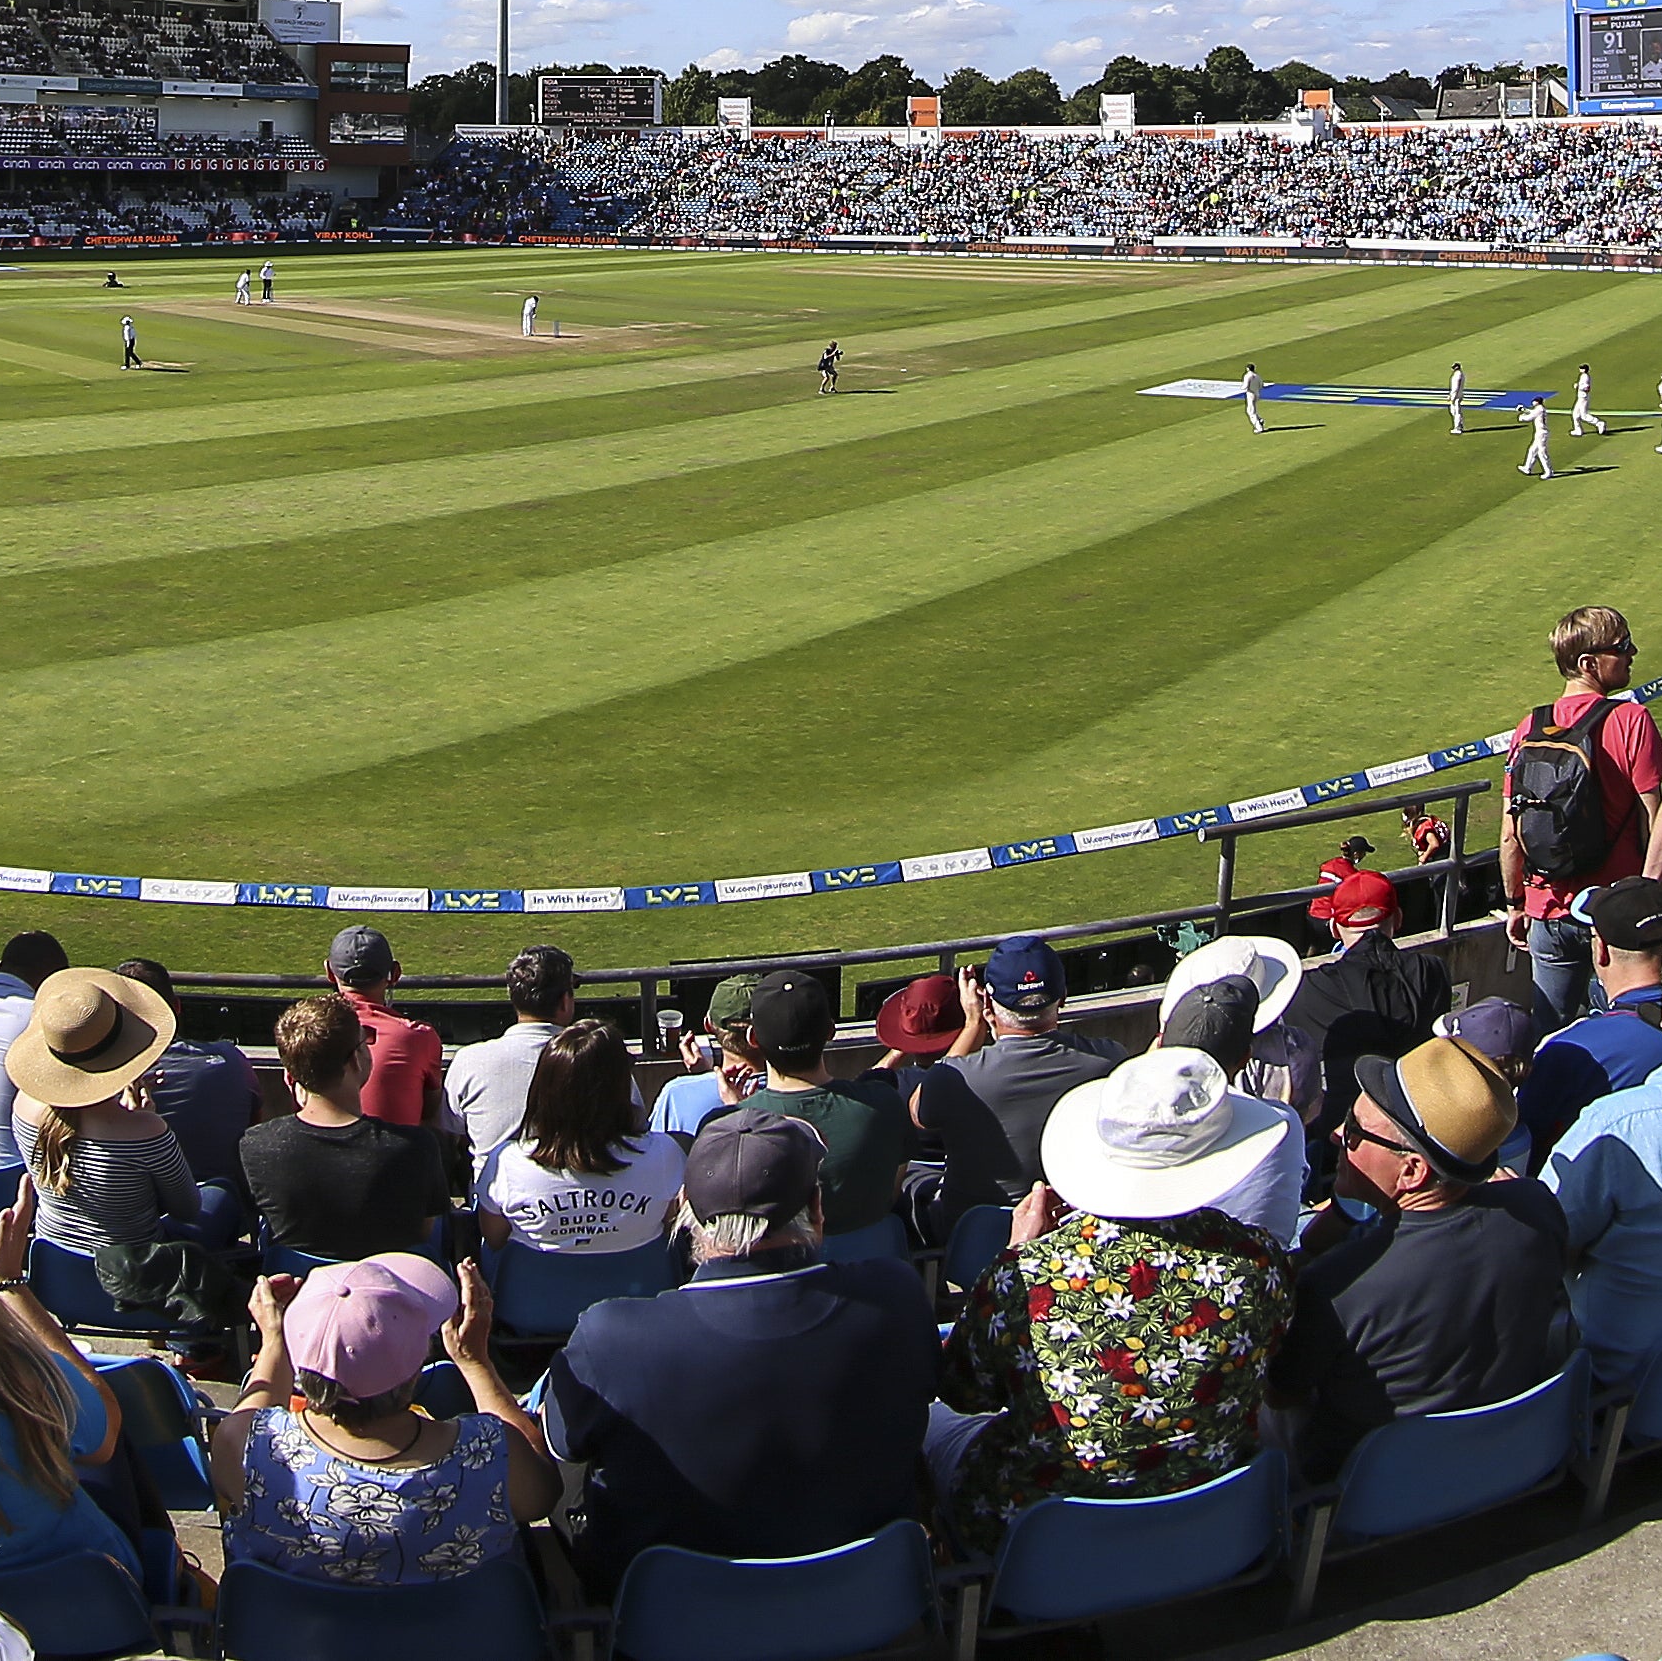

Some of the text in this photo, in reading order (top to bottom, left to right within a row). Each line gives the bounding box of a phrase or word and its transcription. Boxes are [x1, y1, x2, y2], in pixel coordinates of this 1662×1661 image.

[1611, 21, 1642, 29] PUJARA
[1603, 31, 1624, 49] 91
[2, 158, 30, 170] cinch
[38, 158, 65, 170] cinch
[73, 159, 99, 170] cinch
[107, 159, 133, 170] cinch
[140, 160, 166, 170] cinch
[174, 159, 186, 171] IG
[190, 159, 202, 171] IG
[206, 159, 218, 171] IG
[222, 159, 234, 171] IG
[238, 159, 249, 171] IG
[253, 159, 265, 171] IG
[269, 159, 280, 171] IG
[285, 159, 295, 171] IG
[299, 159, 310, 171] IG
[314, 159, 325, 171] IG
[85, 235, 178, 245] CHETESHWAR PUJARA
[314, 231, 374, 241] VIRAT KOHLI
[518, 234, 619, 245] CHETESHWAR PUJARA
[761, 241, 819, 249] VIRAT KOHLI
[966, 243, 1069, 254] CHETESHWAR PUJARA
[1224, 247, 1288, 257] VIRAT KOHLI
[1438, 252, 1548, 264] CHETESHWAR PUJARA
[1248, 801, 1268, 813] With
[1269, 796, 1295, 810] Heart
[337, 892, 420, 906] LV.com/insurance
[533, 893, 610, 905] In With Heart
[521, 1189, 652, 1221] SALTROCK
[560, 1213, 609, 1226] BUDE
[550, 1226, 620, 1236] CORNWALL
